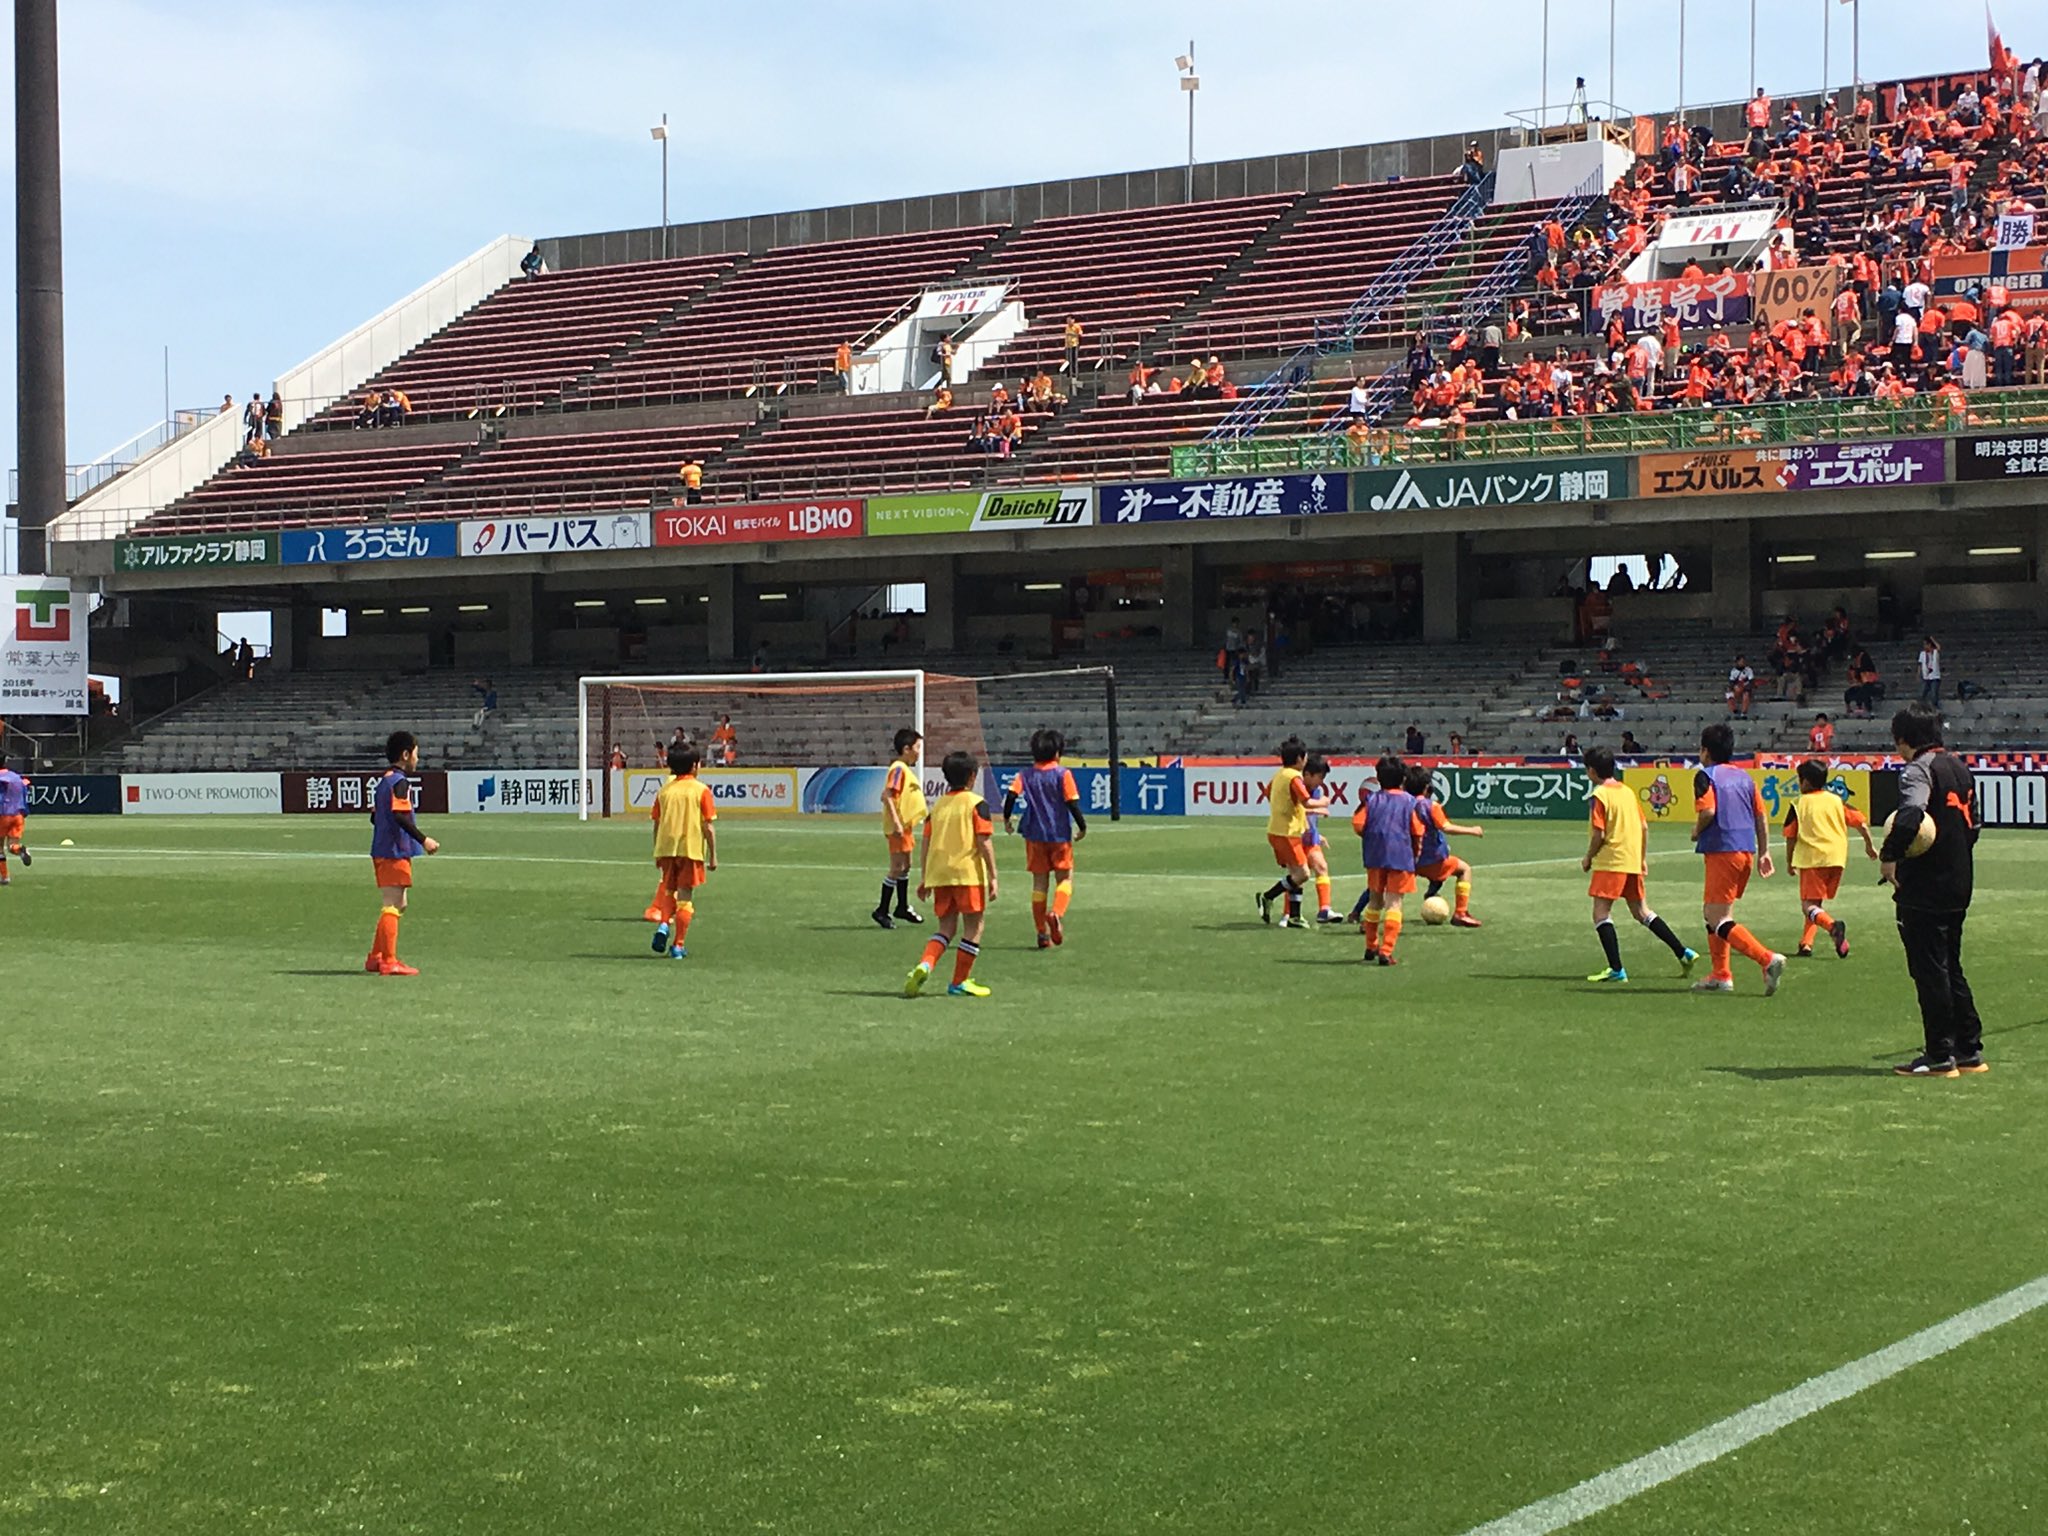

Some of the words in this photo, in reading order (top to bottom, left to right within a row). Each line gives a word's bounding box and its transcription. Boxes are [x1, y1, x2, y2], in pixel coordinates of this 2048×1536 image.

[1690, 223, 1742, 243] IAI
[2000, 221, 2029, 246] 勝
[1759, 269, 1833, 306] 100%
[939, 299, 979, 316] IAI
[1598, 276, 1738, 332] 覚悟完了
[1653, 466, 1765, 494] エスパルス
[1810, 456, 1924, 487] エスポット
[1559, 470, 1609, 502] 静岡
[664, 514, 727, 538] TOKAI
[788, 506, 853, 534] LIBMO
[876, 508, 908, 521] NEXT
[987, 497, 1053, 518] Daiichi
[1056, 501, 1083, 523] TV
[345, 526, 430, 561] ろうきん
[501, 519, 603, 552] パーパス
[141, 539, 267, 567] アルファクラブ静岡
[6, 650, 81, 667] 常葉大学
[2, 679, 35, 688] 2018年
[145, 788, 202, 801] TWO-ONE
[206, 785, 278, 800] PROMOTION
[500, 778, 594, 806] 静岡新聞
[1193, 781, 1249, 804] FUJI
[1523, 802, 1549, 816] Store
